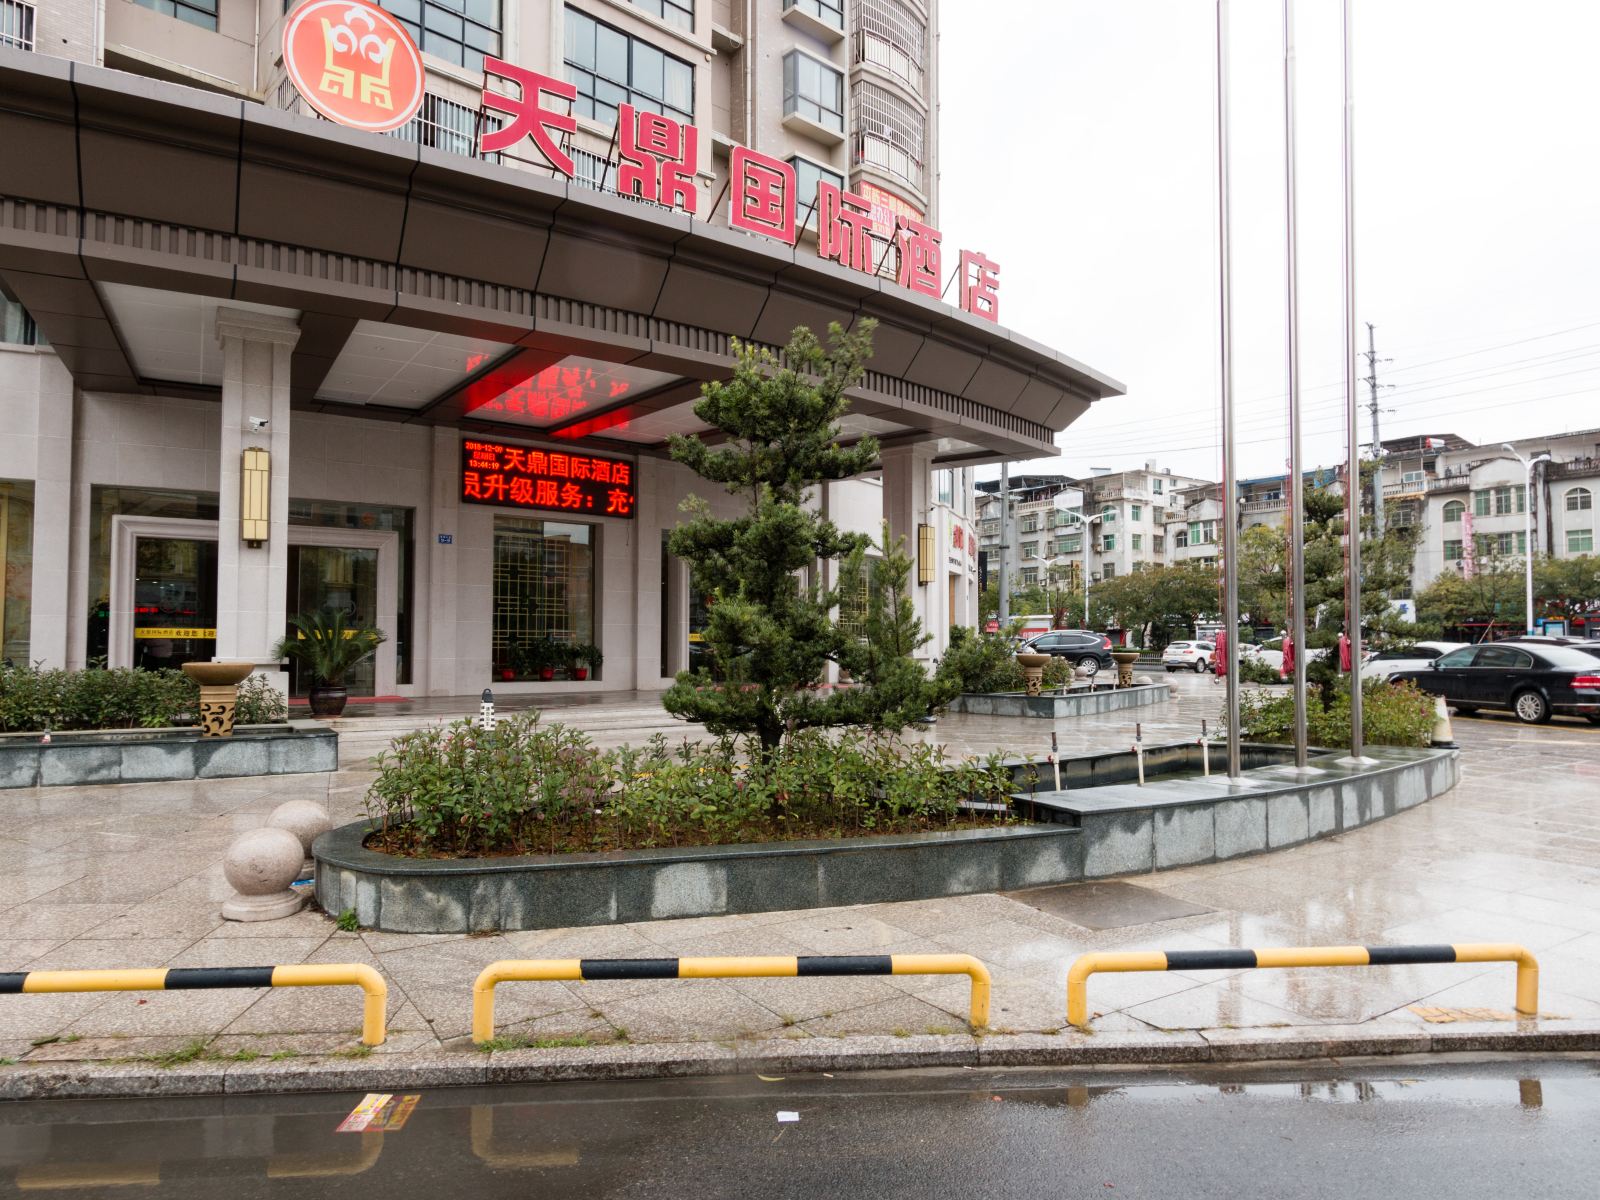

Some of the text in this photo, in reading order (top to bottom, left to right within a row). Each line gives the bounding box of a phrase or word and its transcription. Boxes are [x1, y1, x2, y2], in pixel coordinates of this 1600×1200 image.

[480, 54, 1001, 324] 天鼎国际酒店
[504, 448, 631, 485] 天鼎国际酒店
[464, 471, 634, 513] 员升级服务：充
